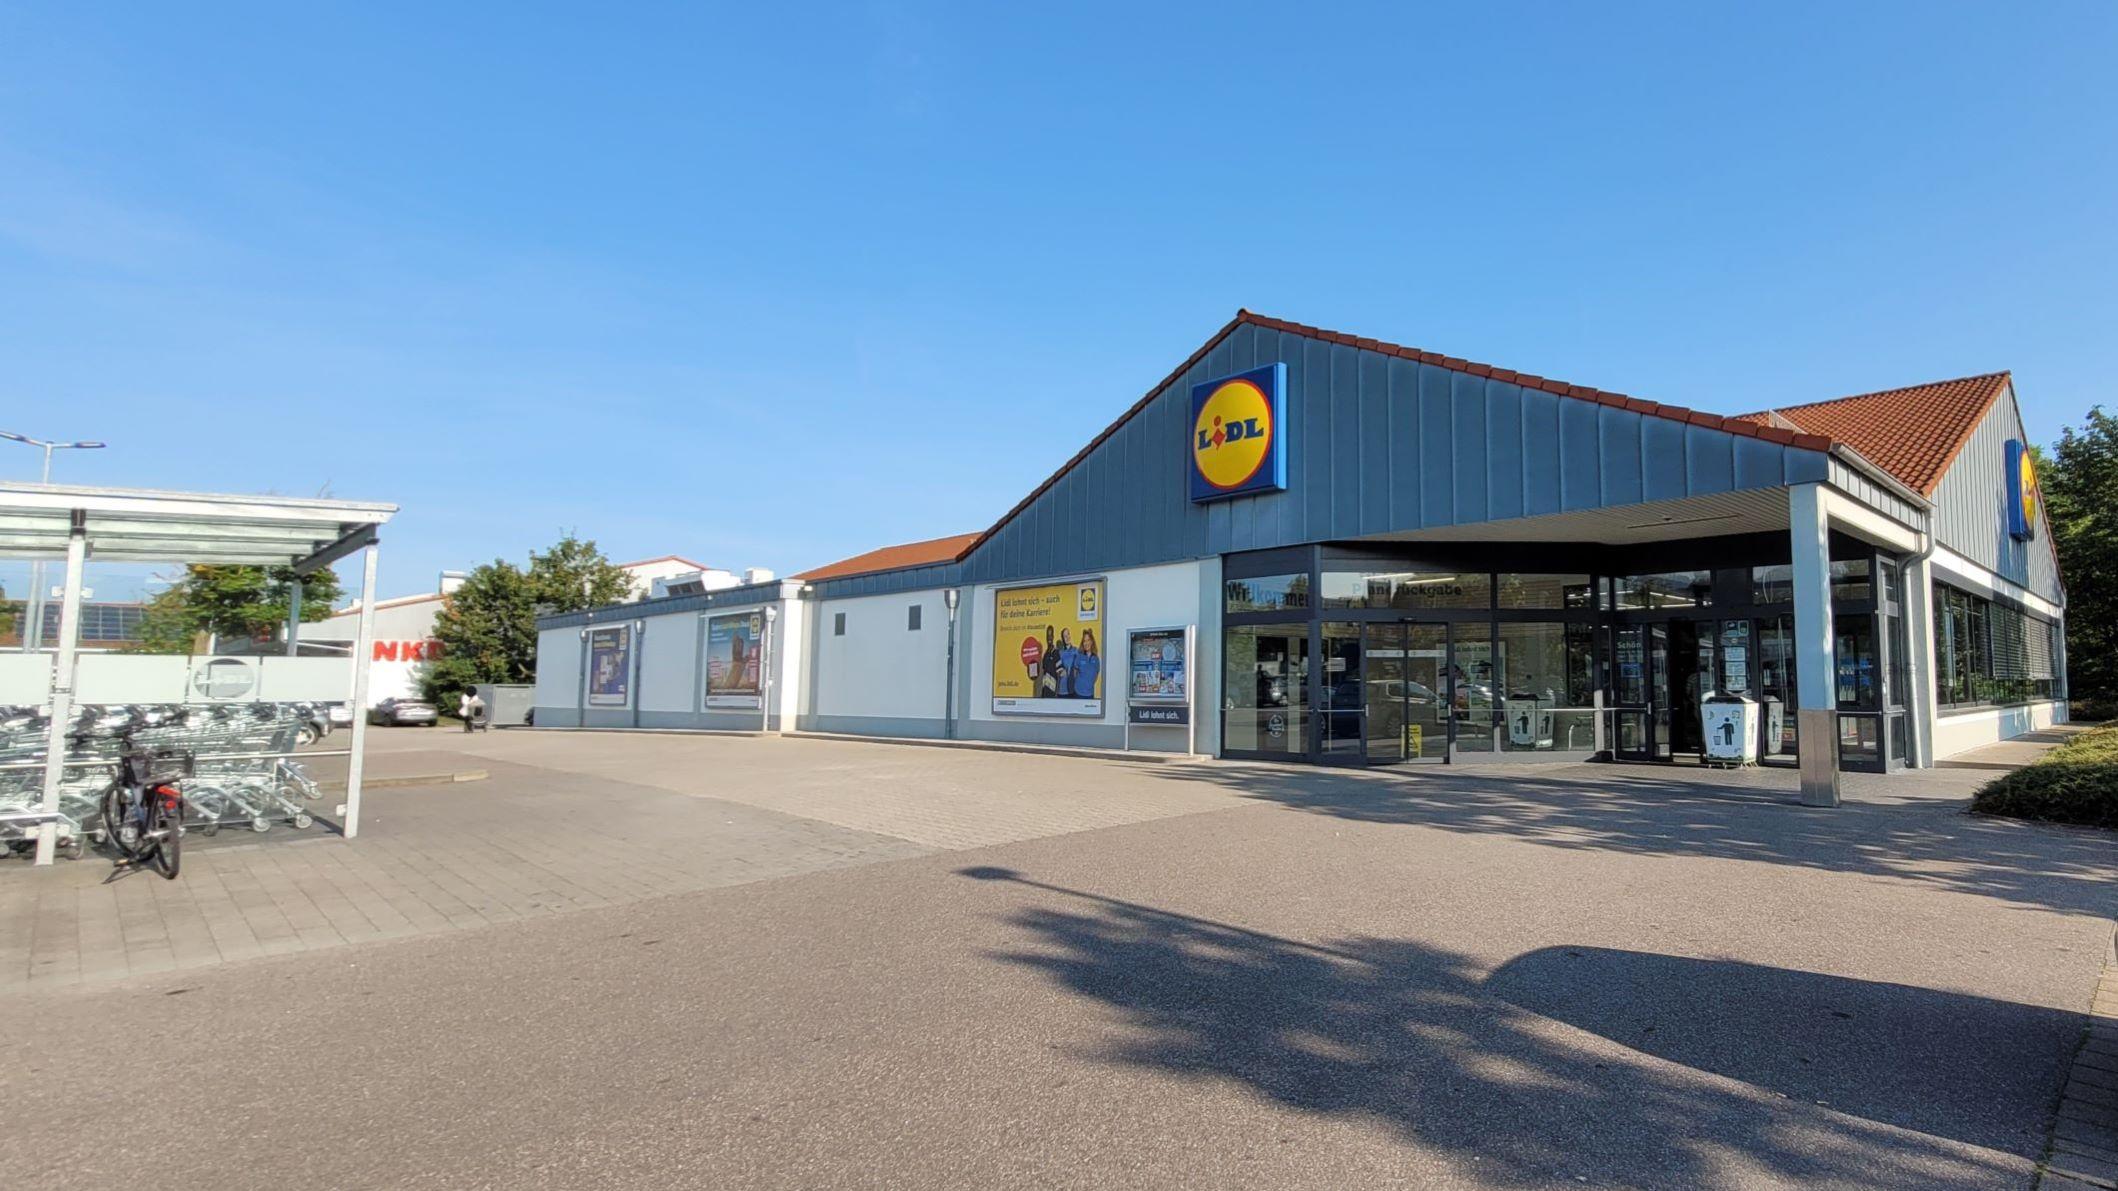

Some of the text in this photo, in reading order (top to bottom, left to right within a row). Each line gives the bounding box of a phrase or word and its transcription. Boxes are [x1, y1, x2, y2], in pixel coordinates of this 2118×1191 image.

[1352, 582, 1462, 599] Panrückgabe
[1139, 710, 1150, 719] Lidl
[1151, 710, 1165, 719] lohnt
